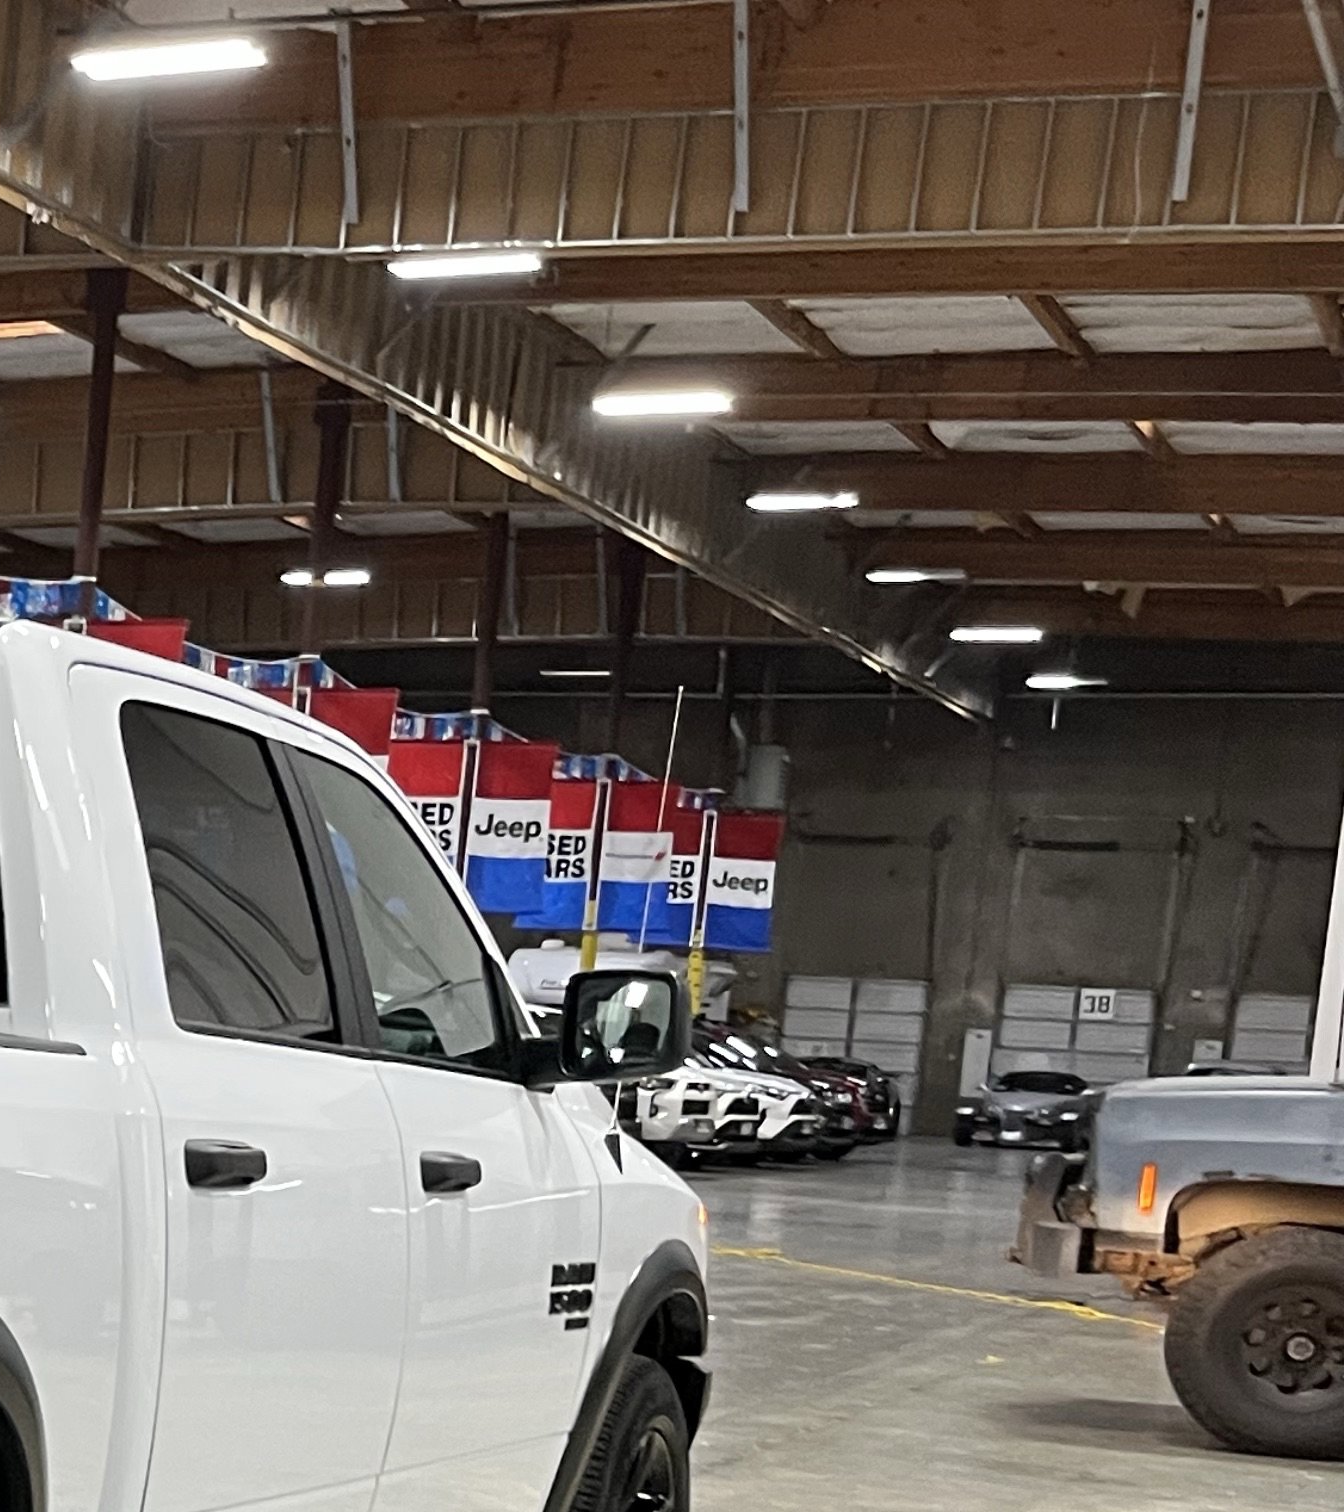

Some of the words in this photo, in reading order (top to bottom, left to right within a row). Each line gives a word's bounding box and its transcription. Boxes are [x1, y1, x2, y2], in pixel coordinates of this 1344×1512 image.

[410, 803, 454, 826] ED
[475, 813, 542, 843] Jeep
[547, 833, 586, 855] SED
[545, 858, 585, 878] RS
[669, 860, 695, 878] ED
[667, 881, 693, 899] RS
[712, 871, 768, 895] Jeep
